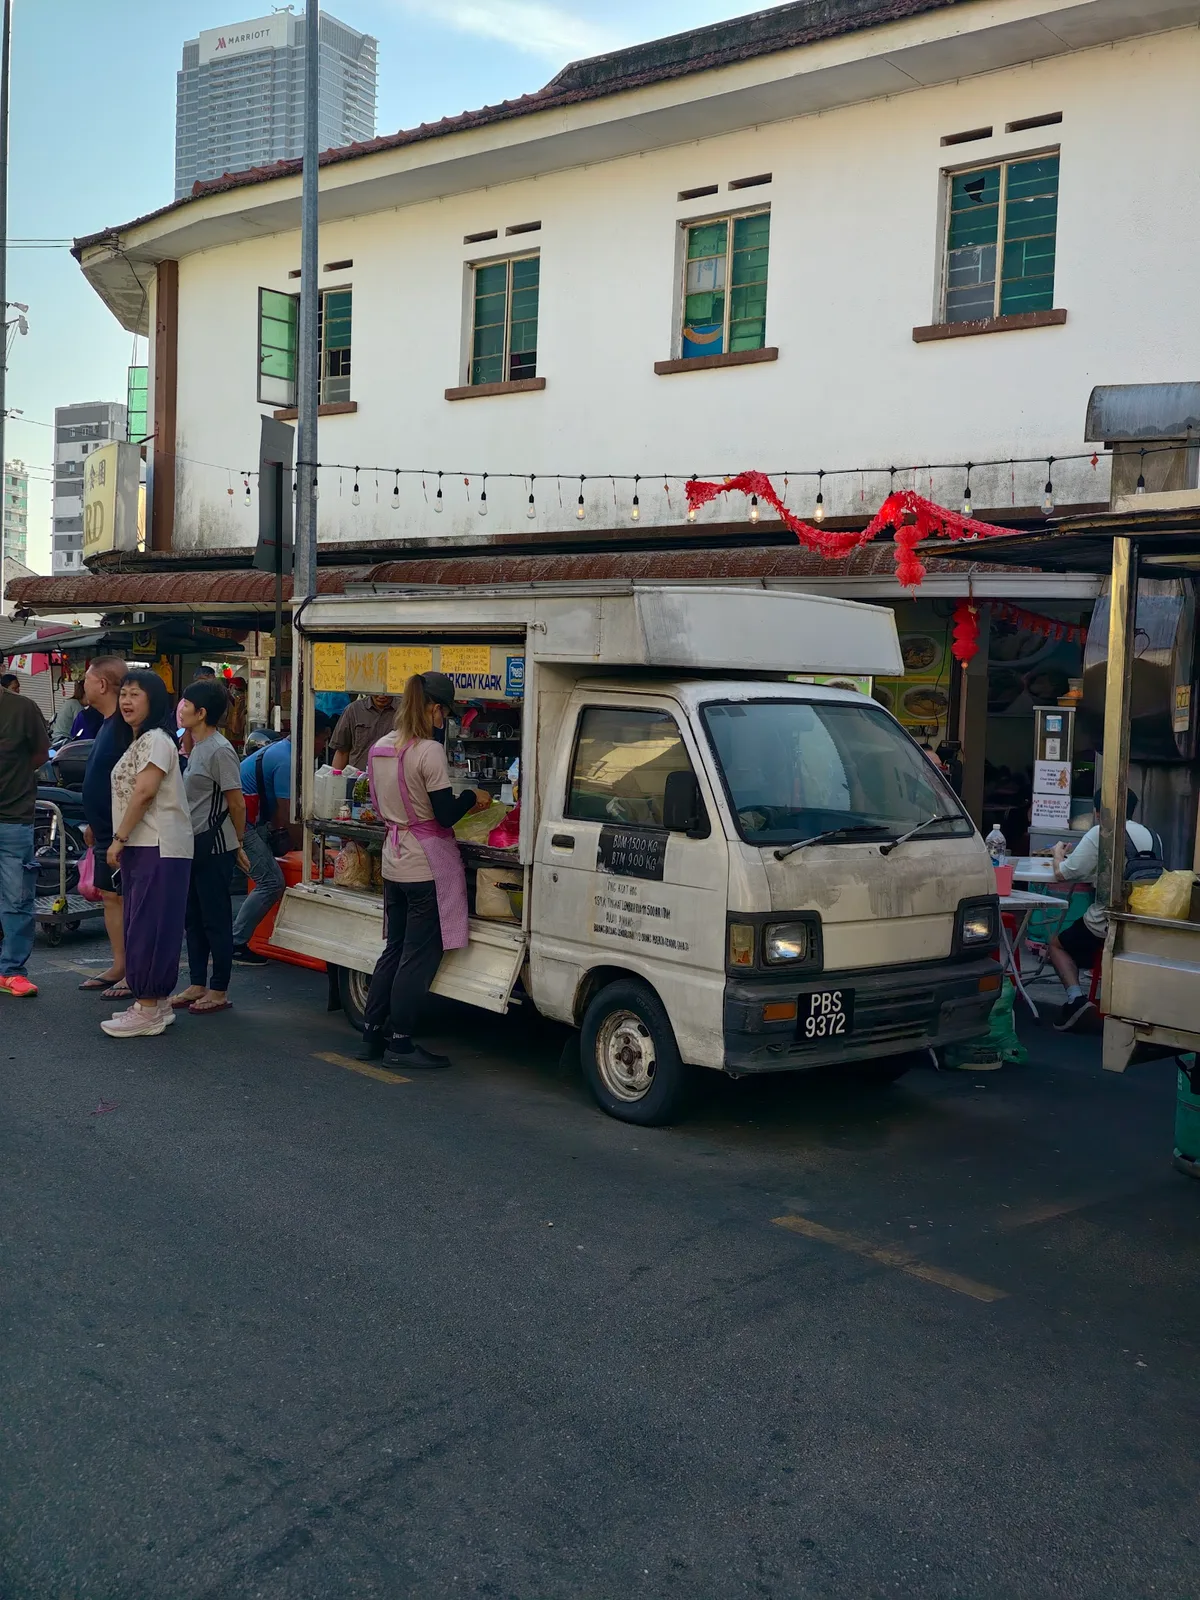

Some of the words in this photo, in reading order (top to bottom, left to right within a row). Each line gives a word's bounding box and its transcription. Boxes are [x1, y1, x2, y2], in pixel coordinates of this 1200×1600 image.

[228, 29, 271, 44] MARRIOTT
[455, 673, 478, 690] KOAY
[479, 674, 502, 691] KARK
[626, 836, 646, 851] 1500
[647, 839, 659, 853] KG
[611, 851, 626, 866] BTM
[628, 853, 644, 867] 900
[645, 855, 657, 871] KG
[810, 990, 842, 1016] PBS
[804, 1012, 846, 1038] 9372
